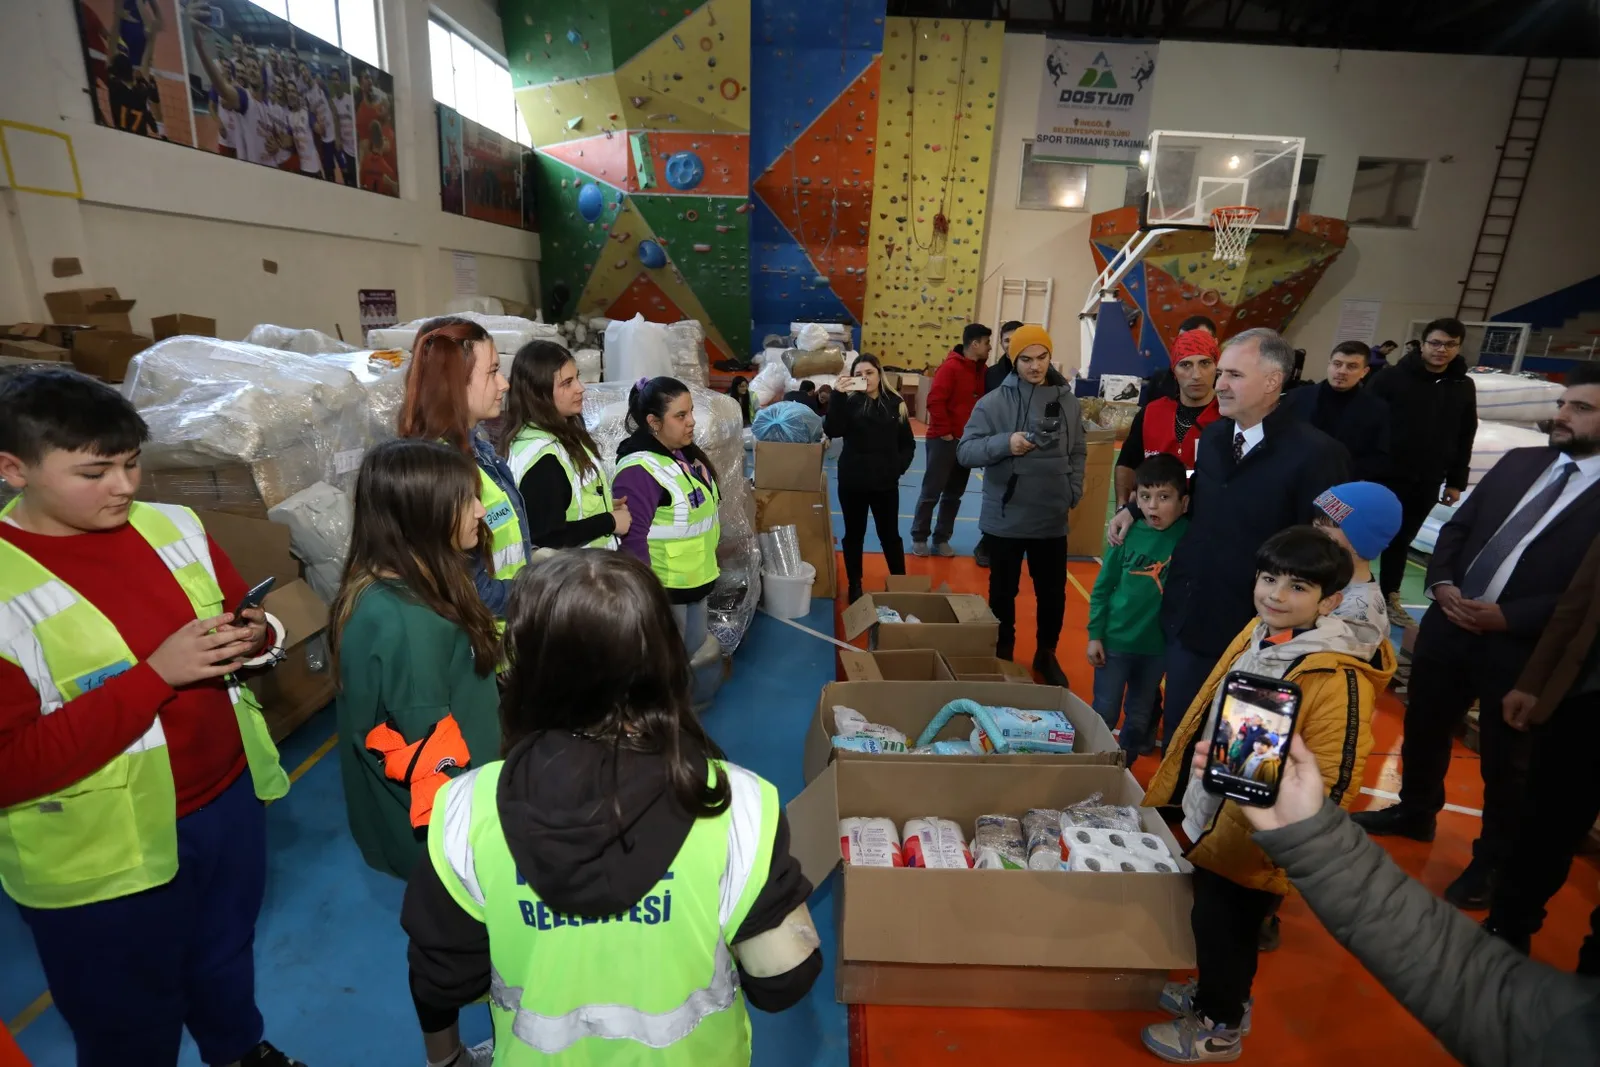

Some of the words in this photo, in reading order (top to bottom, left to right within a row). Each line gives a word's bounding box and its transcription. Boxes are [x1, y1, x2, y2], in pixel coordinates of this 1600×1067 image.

[1060, 89, 1134, 106] DOSTUM
[121, 104, 144, 132] 17
[1036, 134, 1062, 143] SPOR
[1066, 136, 1110, 148] TIRMANIŞ
[1113, 139, 1145, 148] TAKIMI
